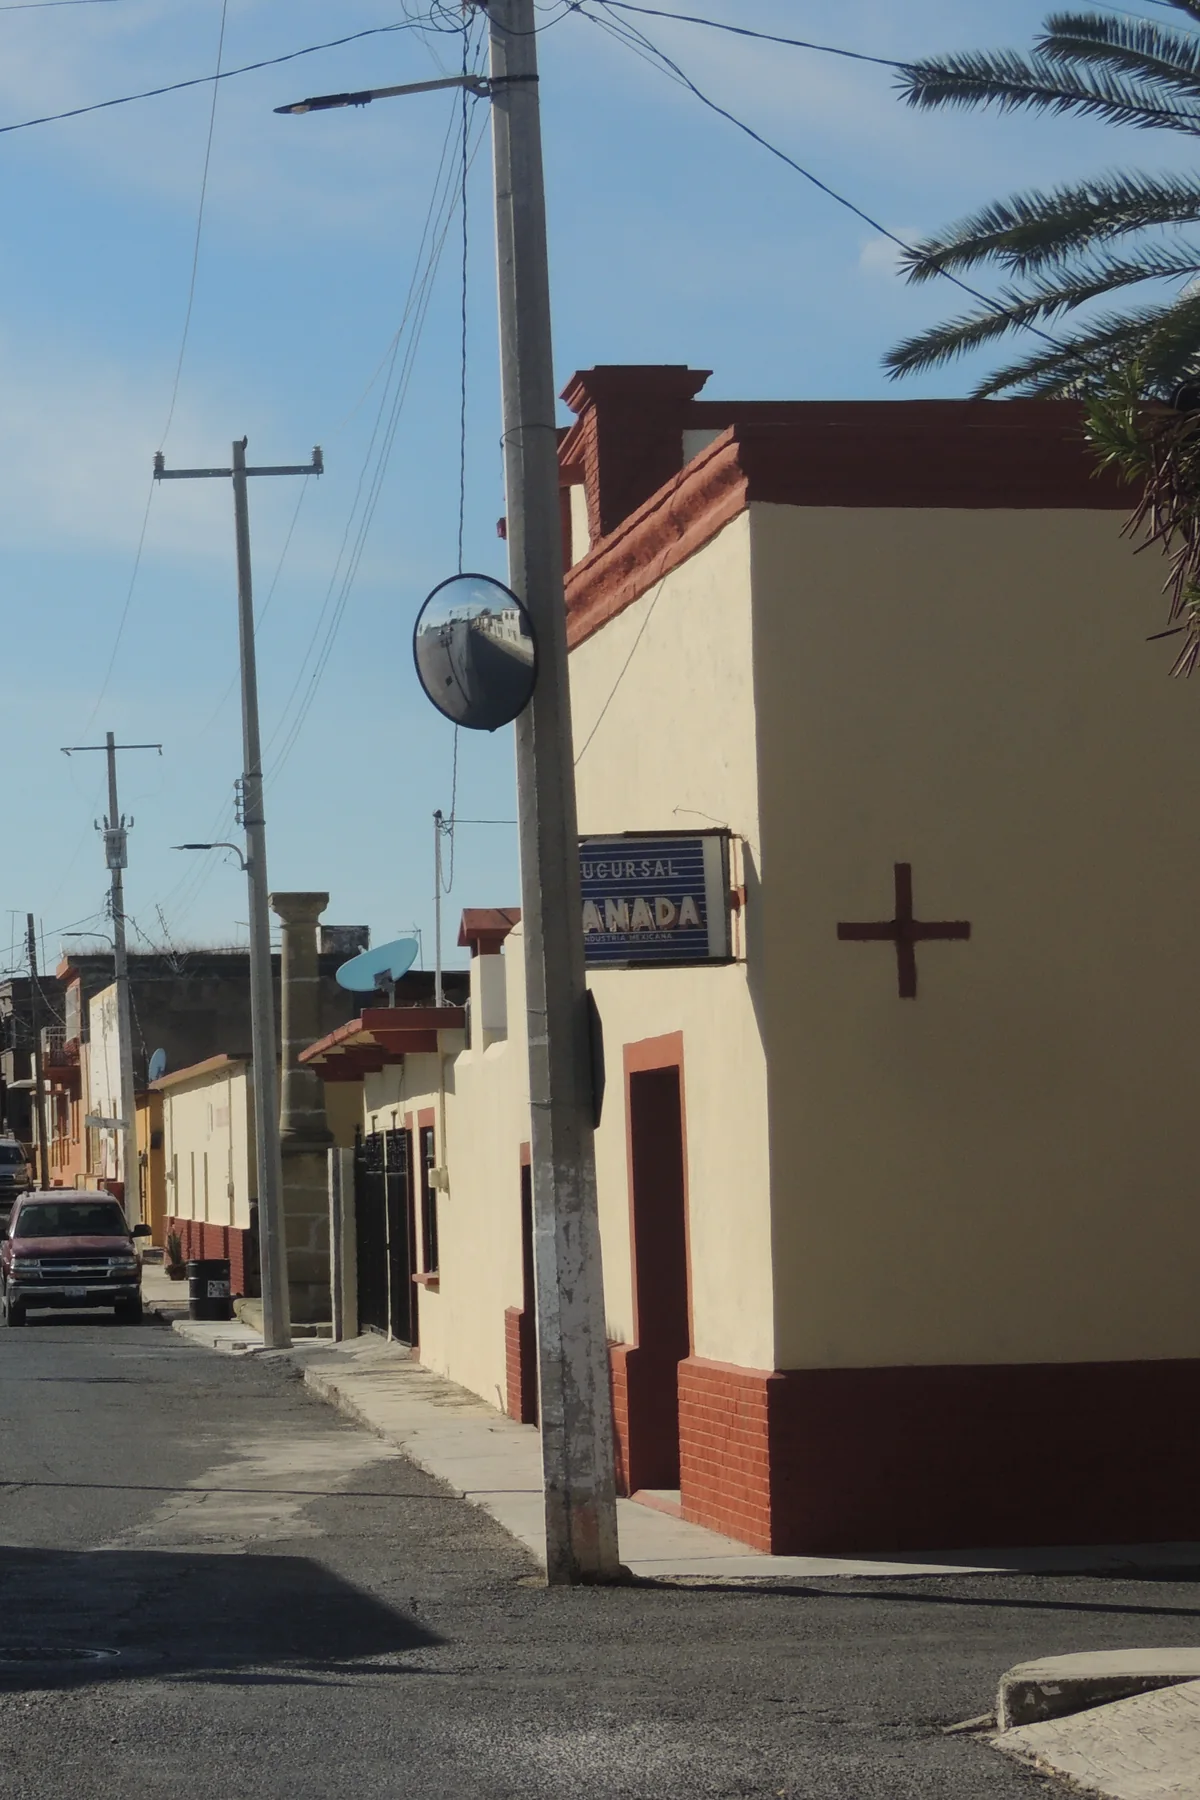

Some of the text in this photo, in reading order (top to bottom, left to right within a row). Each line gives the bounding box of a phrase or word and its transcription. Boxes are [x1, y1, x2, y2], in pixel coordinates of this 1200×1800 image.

[582, 860, 679, 879] UCURSAL
[582, 896, 702, 932] ANADA
[584, 932, 673, 943] NDUSTRIA MEXICANA
